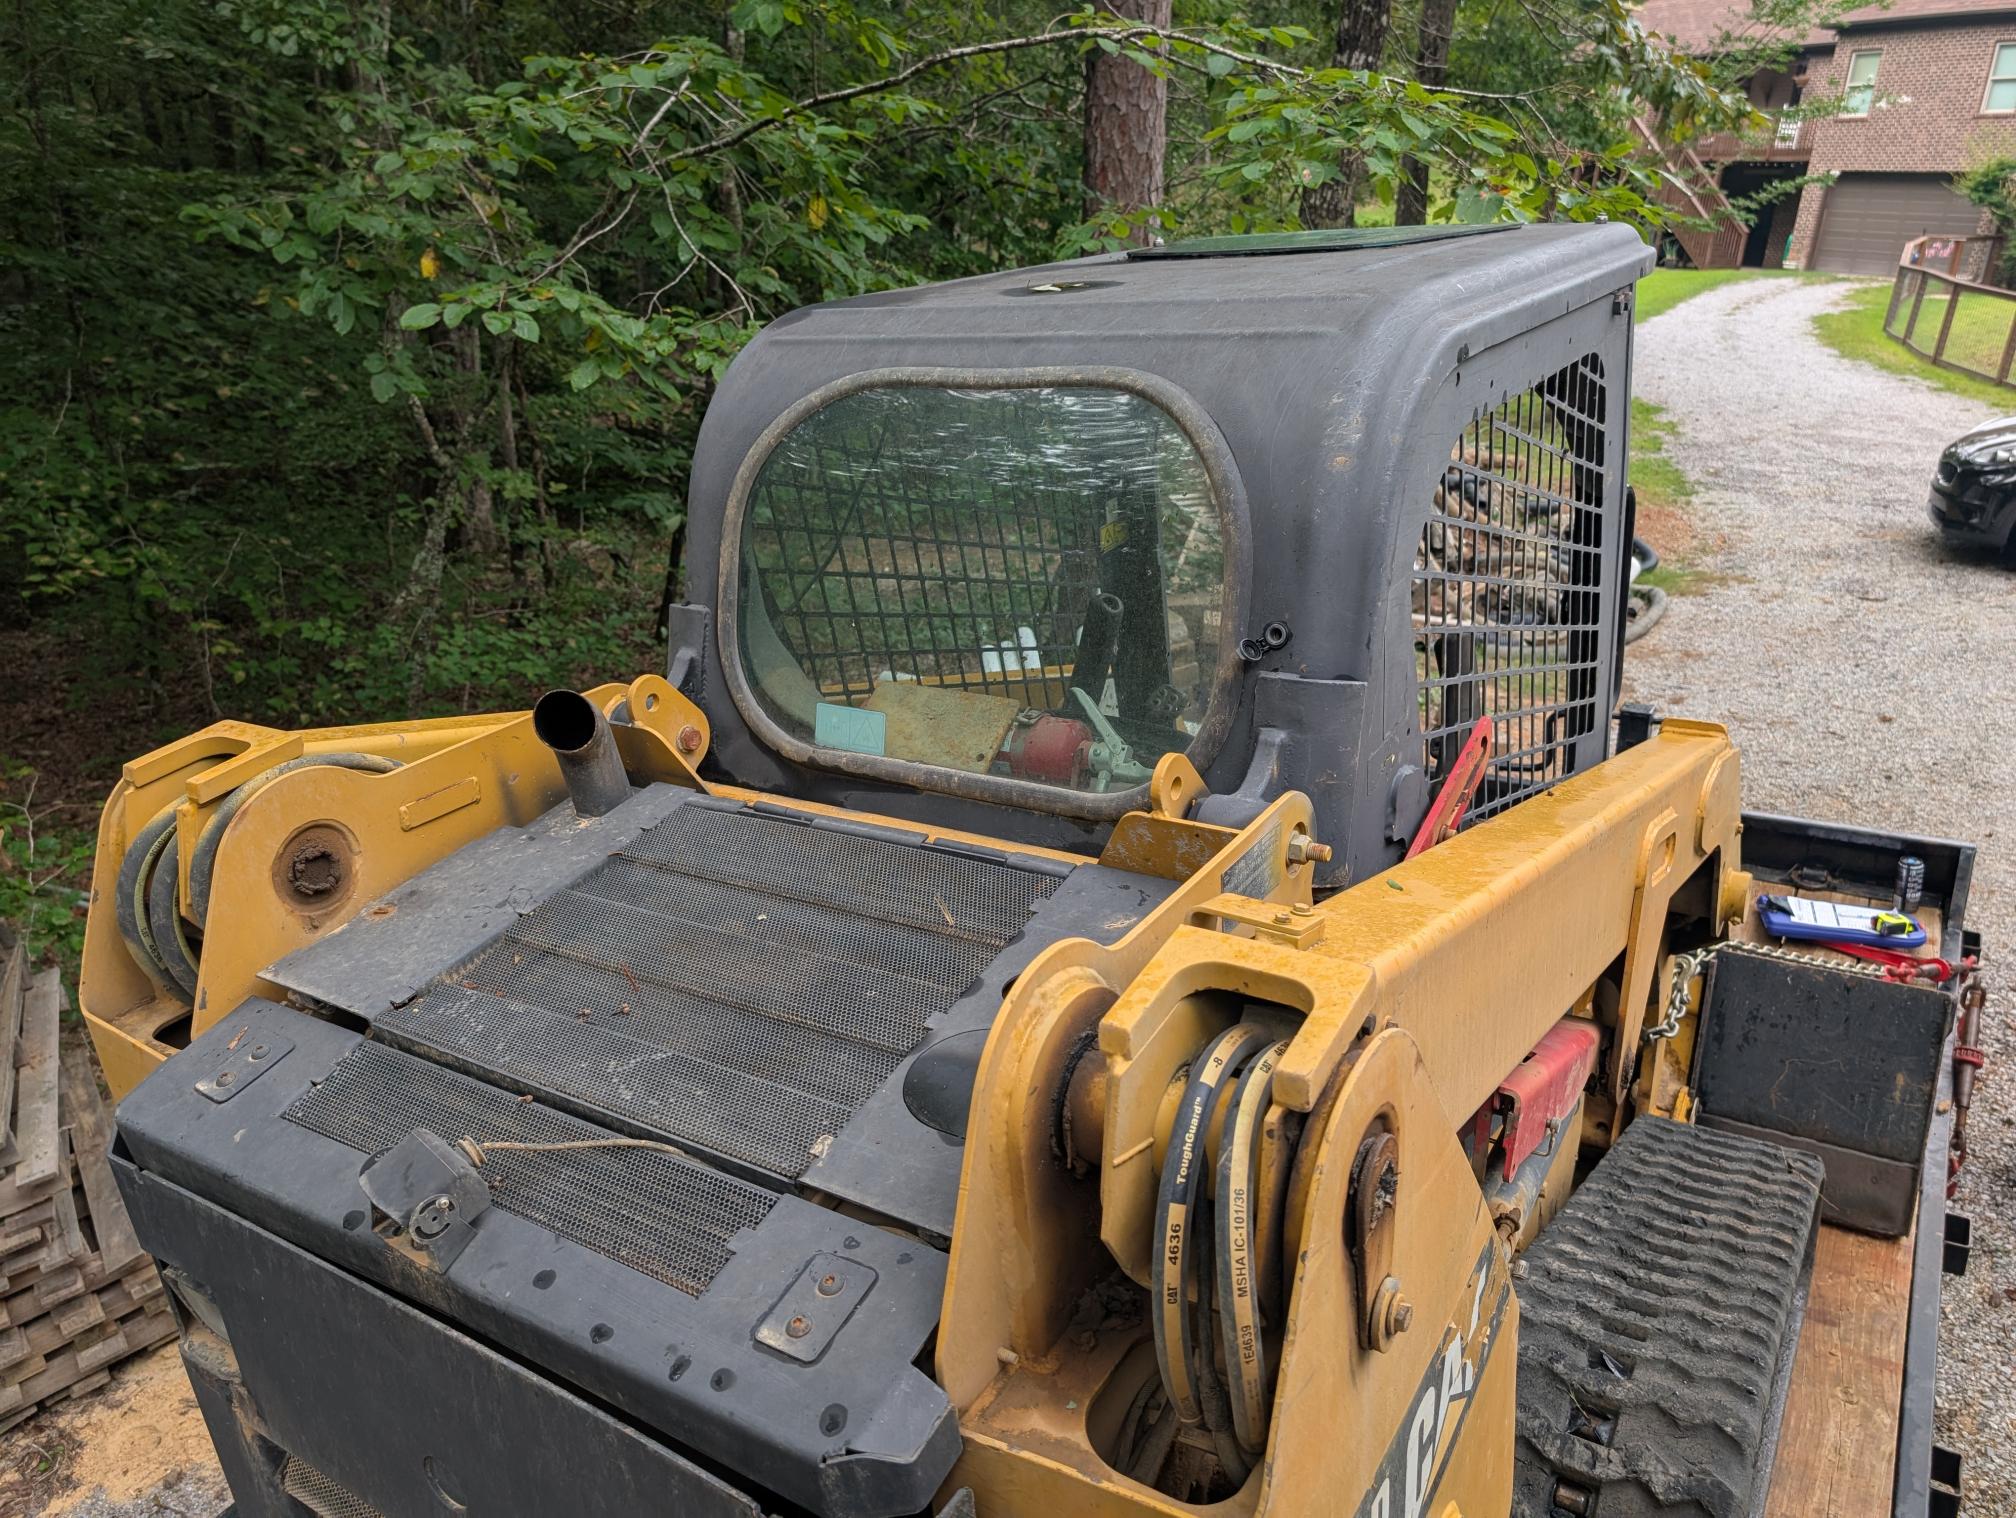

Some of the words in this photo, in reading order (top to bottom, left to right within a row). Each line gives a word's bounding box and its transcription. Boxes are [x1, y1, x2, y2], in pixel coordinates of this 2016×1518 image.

[1212, 1056, 1224, 1069] -8
[1259, 1060, 1273, 1073] CAT
[1233, 1187, 1246, 1253] IC-101/36
[1168, 1223, 1182, 1266] 4636
[1167, 1282, 1179, 1305] CAT
[1236, 1256, 1248, 1298] MSHA
[1241, 1324, 1256, 1365] 1E4639
